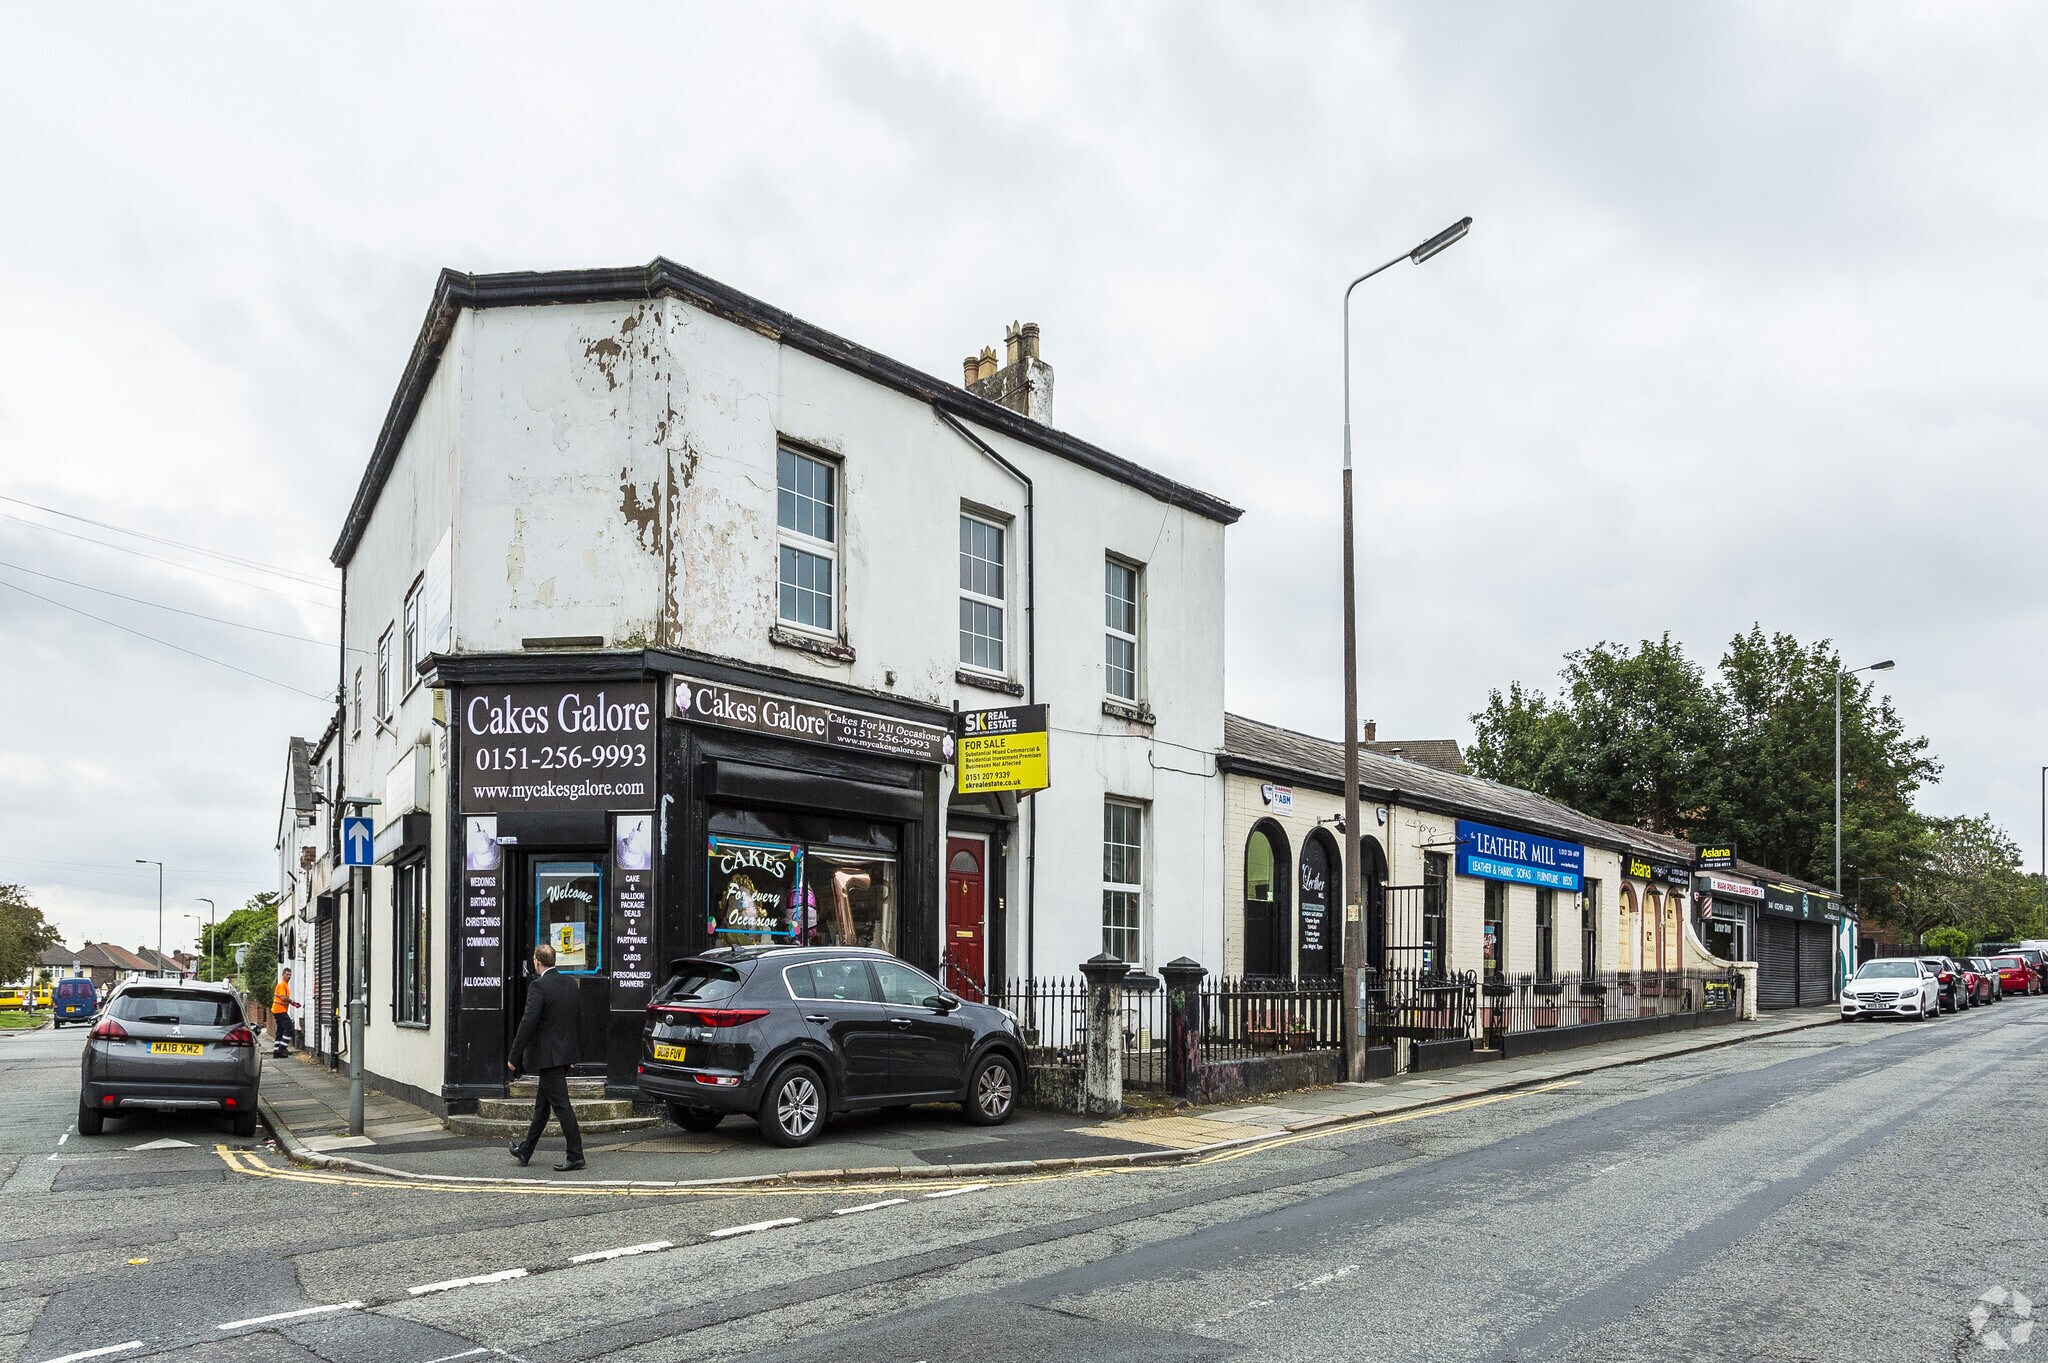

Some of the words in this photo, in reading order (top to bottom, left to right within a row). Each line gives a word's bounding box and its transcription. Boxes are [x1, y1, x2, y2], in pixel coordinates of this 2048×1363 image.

[467, 694, 549, 736] Cakes
[558, 692, 650, 733] Galore
[696, 688, 756, 723] Cakes
[762, 701, 825, 736] Galore
[988, 711, 1009, 720] REAL
[828, 713, 858, 726] Cakes
[860, 719, 877, 730] For
[879, 722, 894, 734] All
[896, 726, 940, 742] Occasions
[965, 712, 987, 732] SK
[988, 719, 1017, 730] ESTATE
[837, 736, 932, 758] www.mycakesgalore.com
[844, 726, 930, 749] 0151-256-9993
[965, 741, 982, 750] FOR
[984, 739, 1005, 748] SALE
[476, 744, 646, 770] 0151-256-9993
[473, 779, 644, 801] www.mycakesgalore.com
[965, 779, 1021, 788] skrealestate.co.uk
[1279, 794, 1290, 805] ABM
[1477, 833, 1527, 860] LEATHER
[1532, 844, 1556, 865] MILL
[1701, 847, 1730, 858] Asiana
[720, 849, 786, 879] CAKES
[1472, 861, 1492, 874] LEATHER
[1493, 866, 1496, 874] &
[1498, 866, 1513, 877] FABRIC
[1516, 869, 1531, 880] SOFAS
[1537, 871, 1558, 884] FURNITURE
[1562, 876, 1573, 886] BEDS
[1630, 858, 1651, 878] Asiana
[470, 877, 496, 887] WEDDINGS
[1717, 882, 1726, 890] MARK
[1727, 883, 1738, 892] POWELL
[470, 897, 496, 907] BIRTHDAYS
[546, 882, 593, 904] Welcome
[726, 882, 747, 900] For
[751, 891, 780, 908] every
[466, 917, 500, 926] CHRISTENINGS
[728, 909, 777, 928] Occasion
[466, 937, 499, 947] COMMUNIONS
[480, 957, 485, 966] &
[464, 977, 472, 987] ALL
[473, 977, 501, 987] OCCASIONS
[155, 1044, 178, 1052] MA18
[180, 1044, 199, 1053] XMZ
